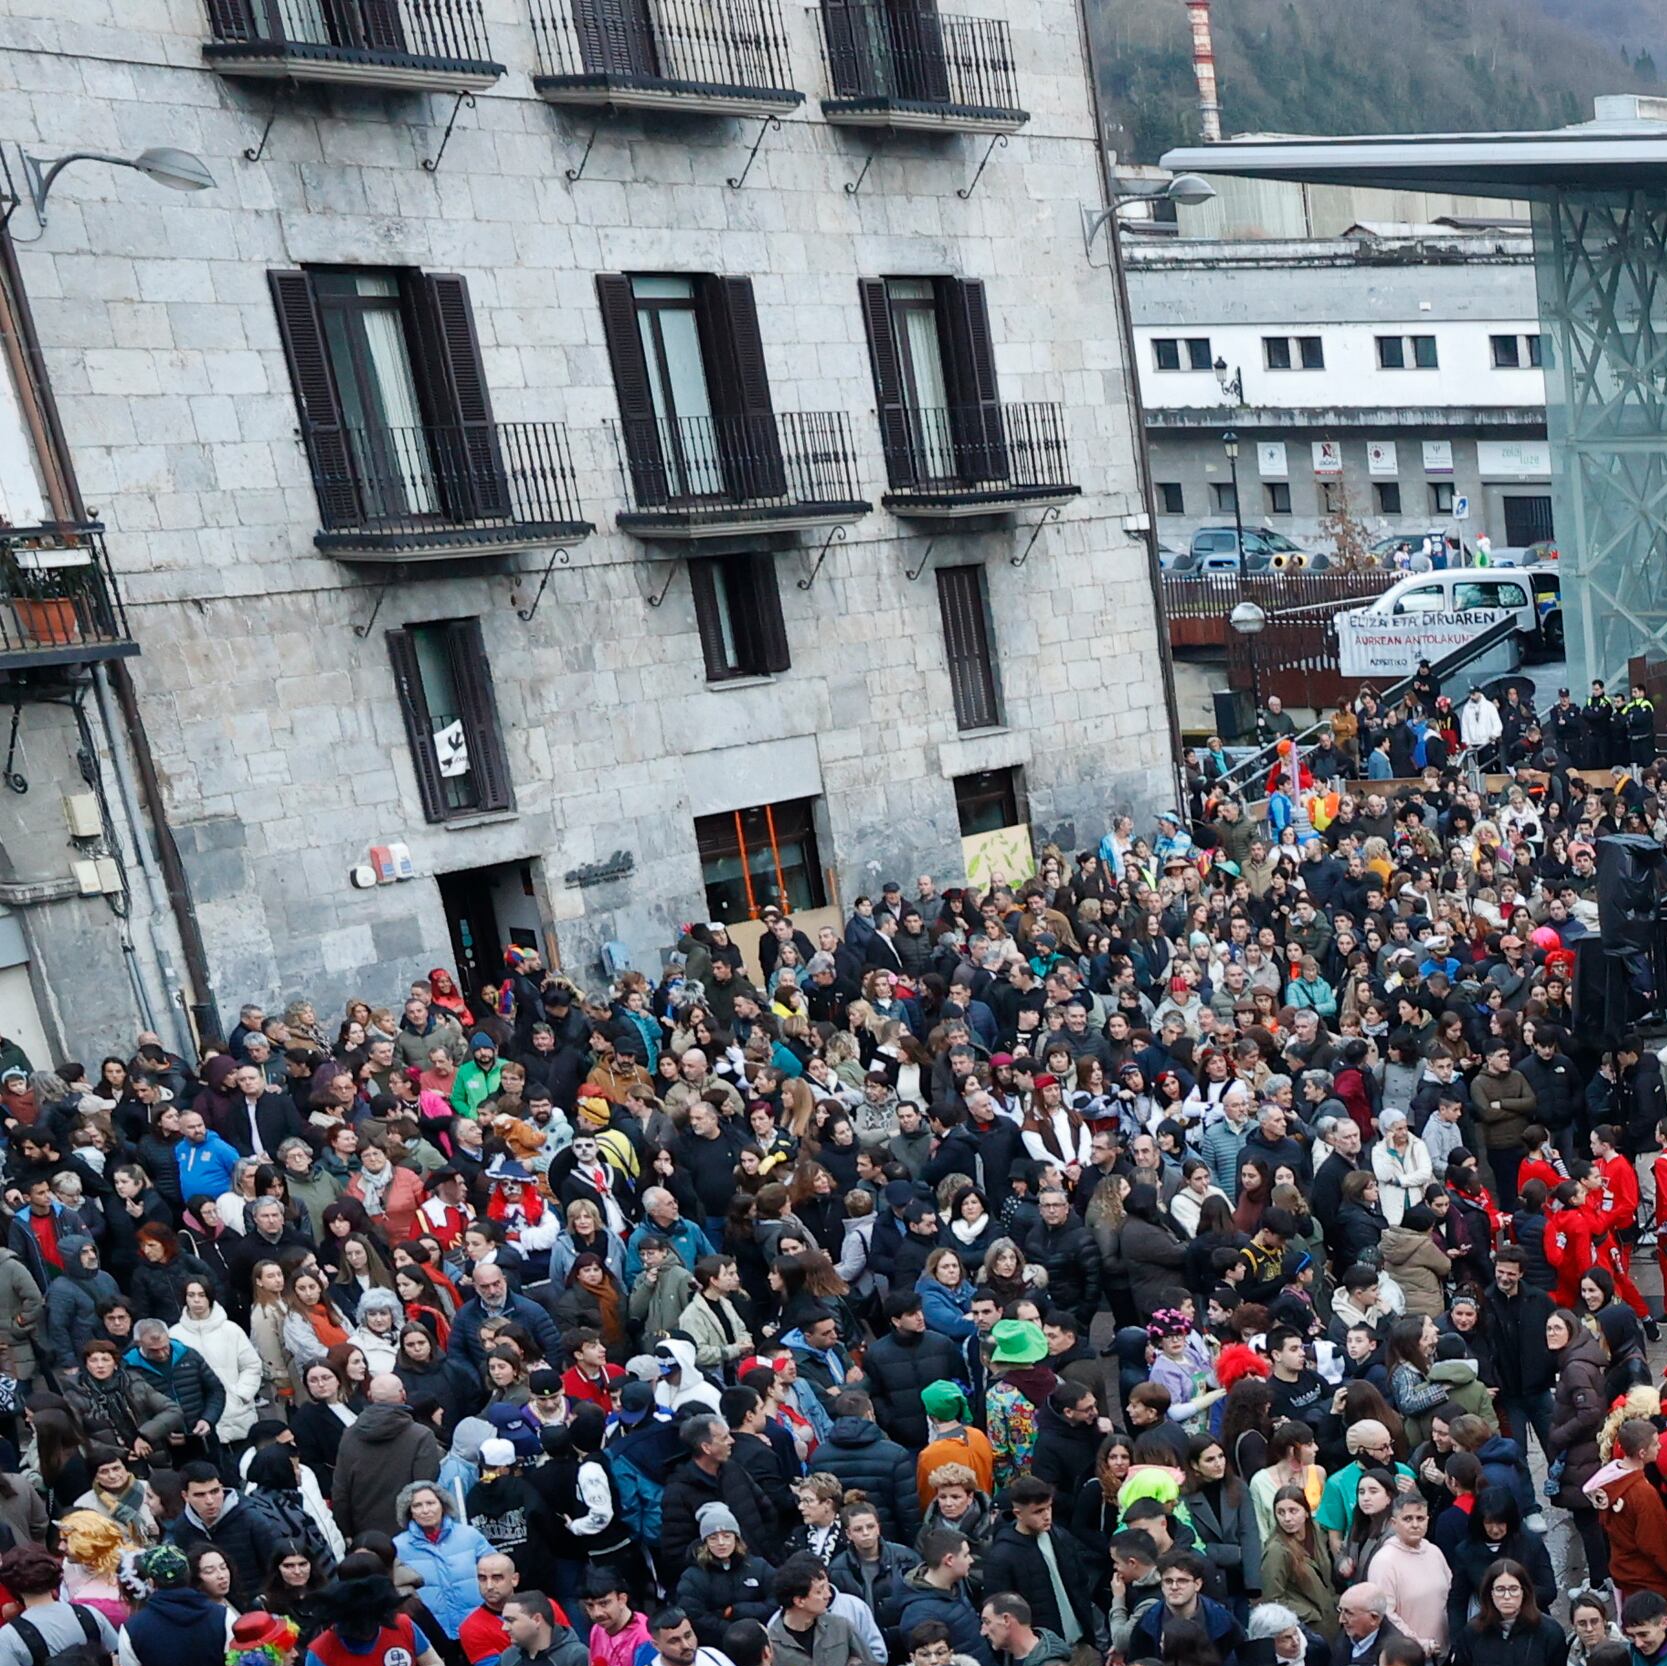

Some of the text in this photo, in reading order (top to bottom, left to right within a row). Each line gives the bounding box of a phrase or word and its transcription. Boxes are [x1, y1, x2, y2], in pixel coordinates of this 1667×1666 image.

[1350, 611, 1496, 628] ELIZA ETA DIRUAREN
[1355, 633, 1402, 646] AURREAN
